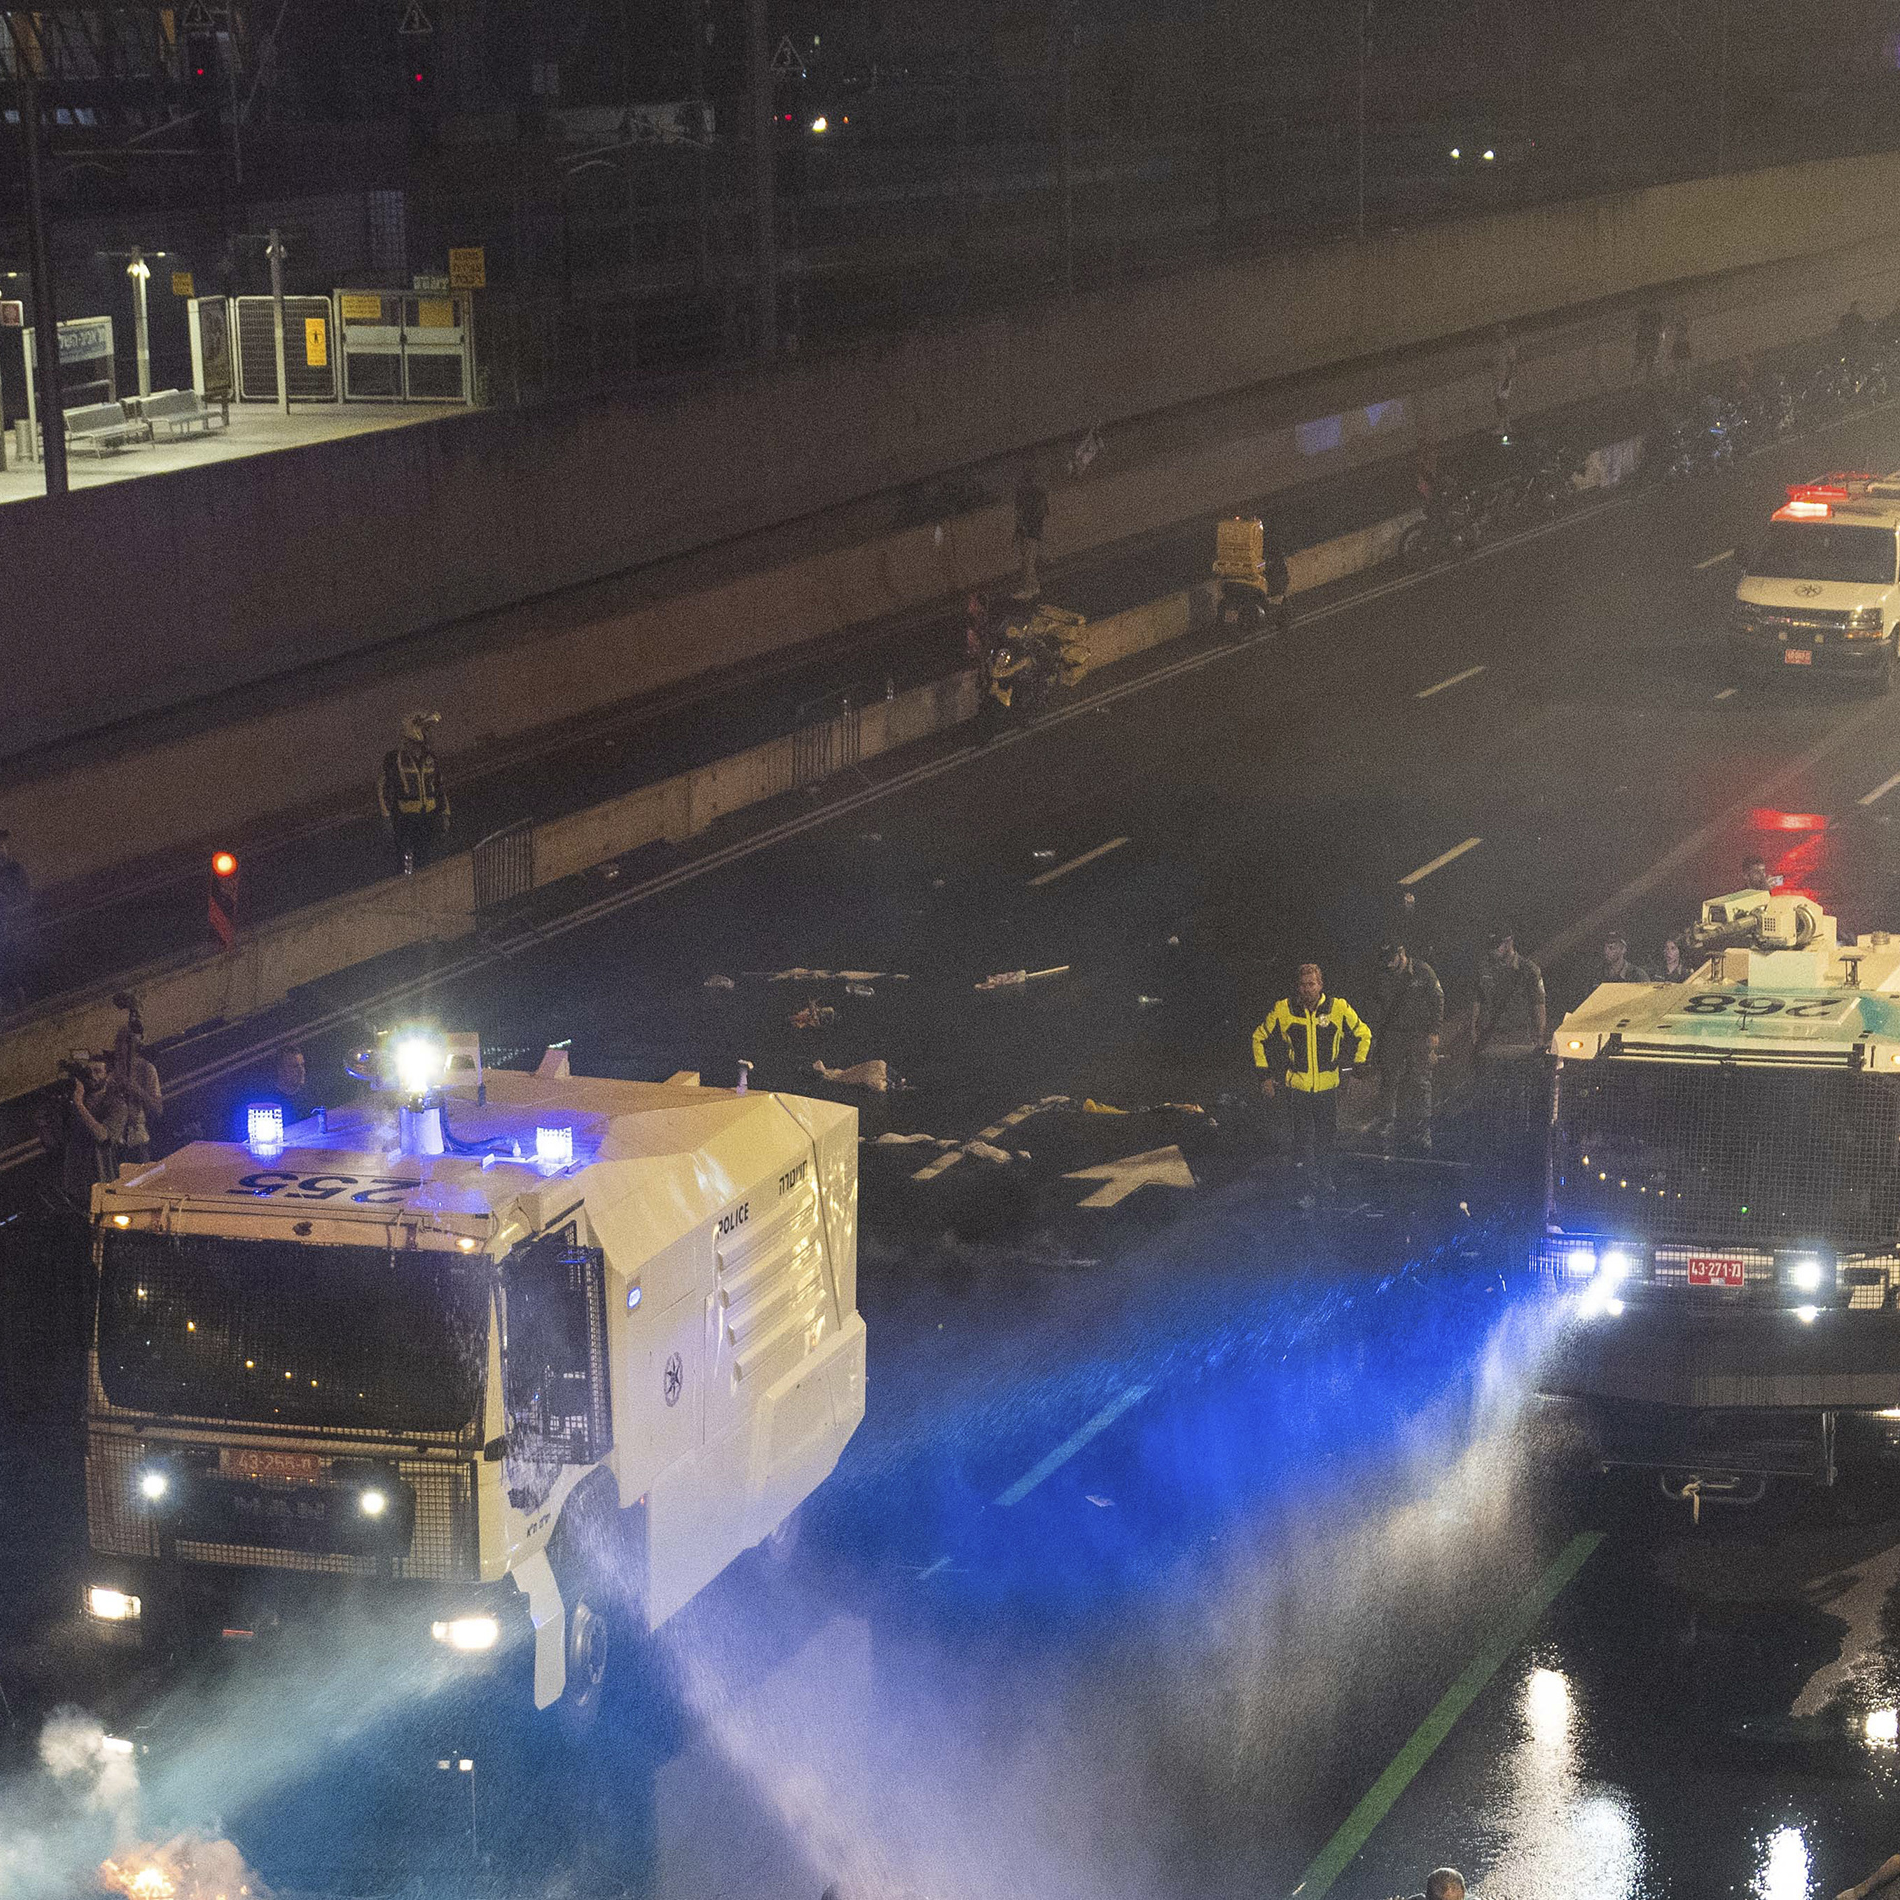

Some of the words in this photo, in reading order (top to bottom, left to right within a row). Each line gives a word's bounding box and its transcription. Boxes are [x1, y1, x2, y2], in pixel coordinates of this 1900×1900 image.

[1683, 994, 1846, 1018] 268
[225, 1172, 424, 1203] 255
[717, 1202, 750, 1240] POLICE
